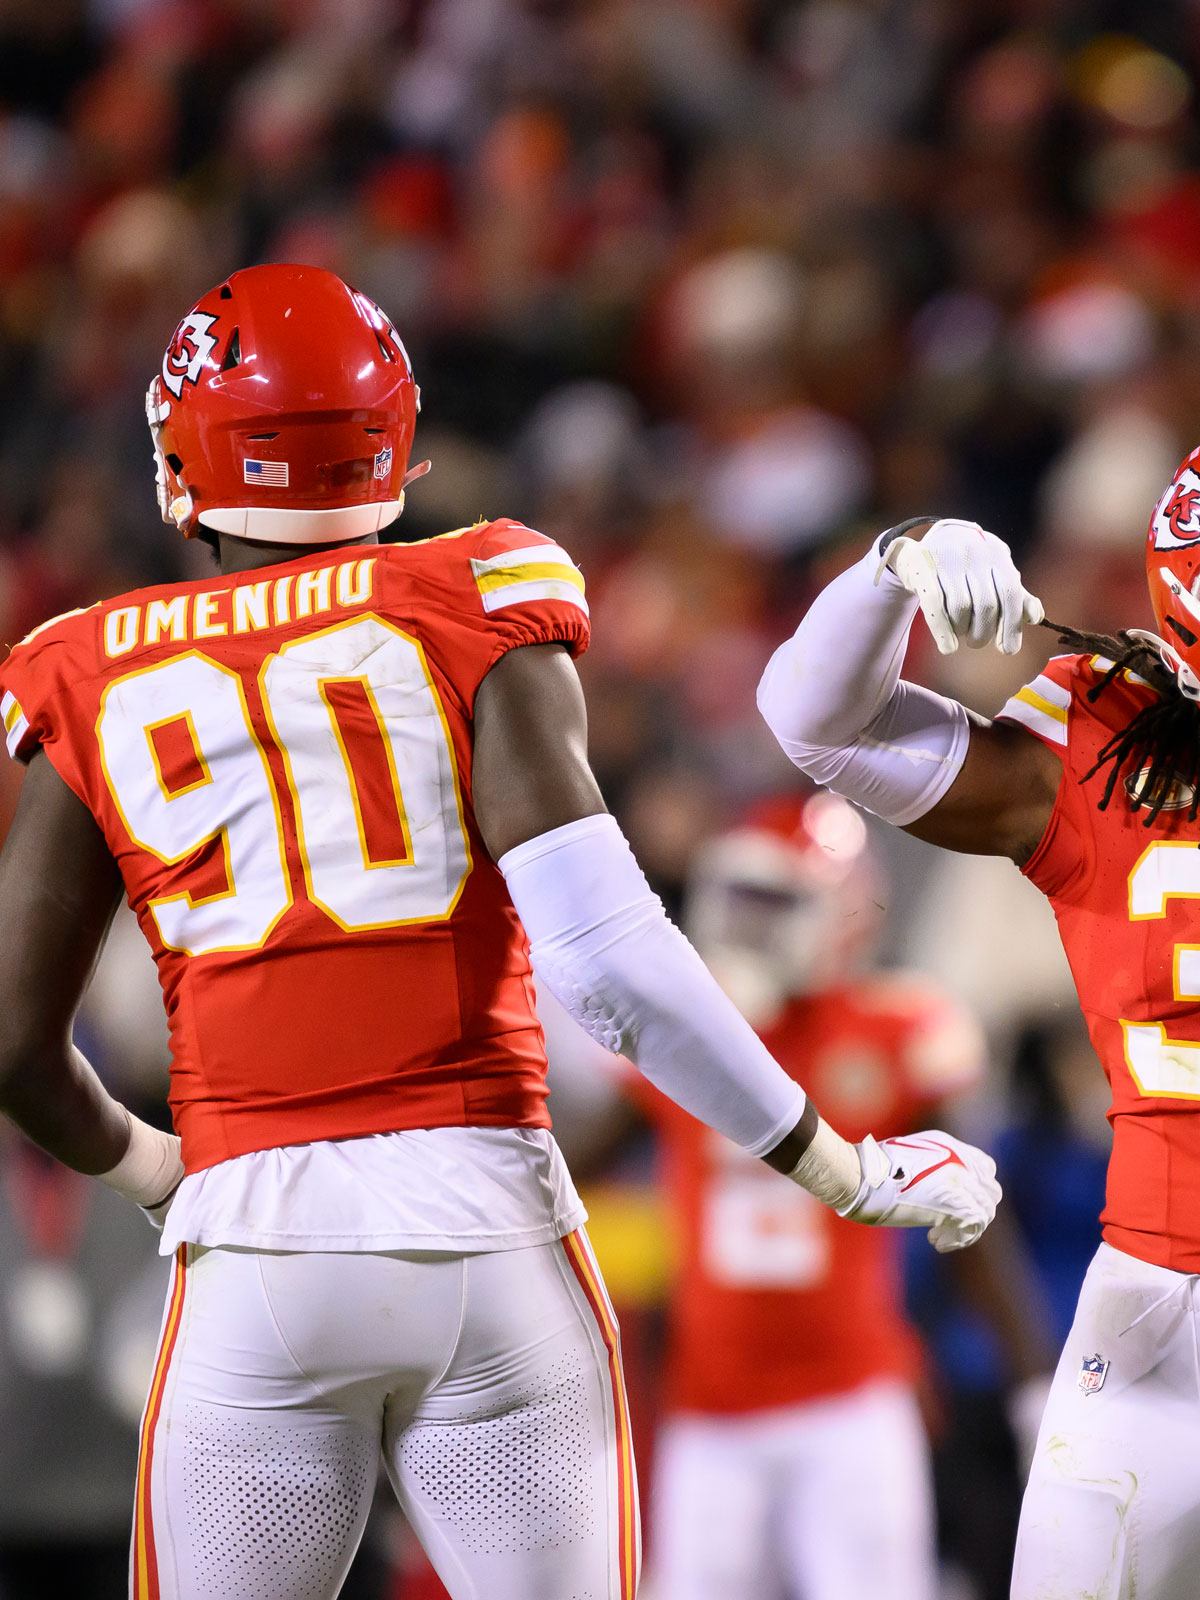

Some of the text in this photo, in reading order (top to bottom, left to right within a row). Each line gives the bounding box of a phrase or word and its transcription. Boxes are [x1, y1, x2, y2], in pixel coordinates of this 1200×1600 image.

[103, 557, 378, 660] OMENIHU
[94, 610, 475, 957] 90
[1080, 1371, 1099, 1388] NFL
